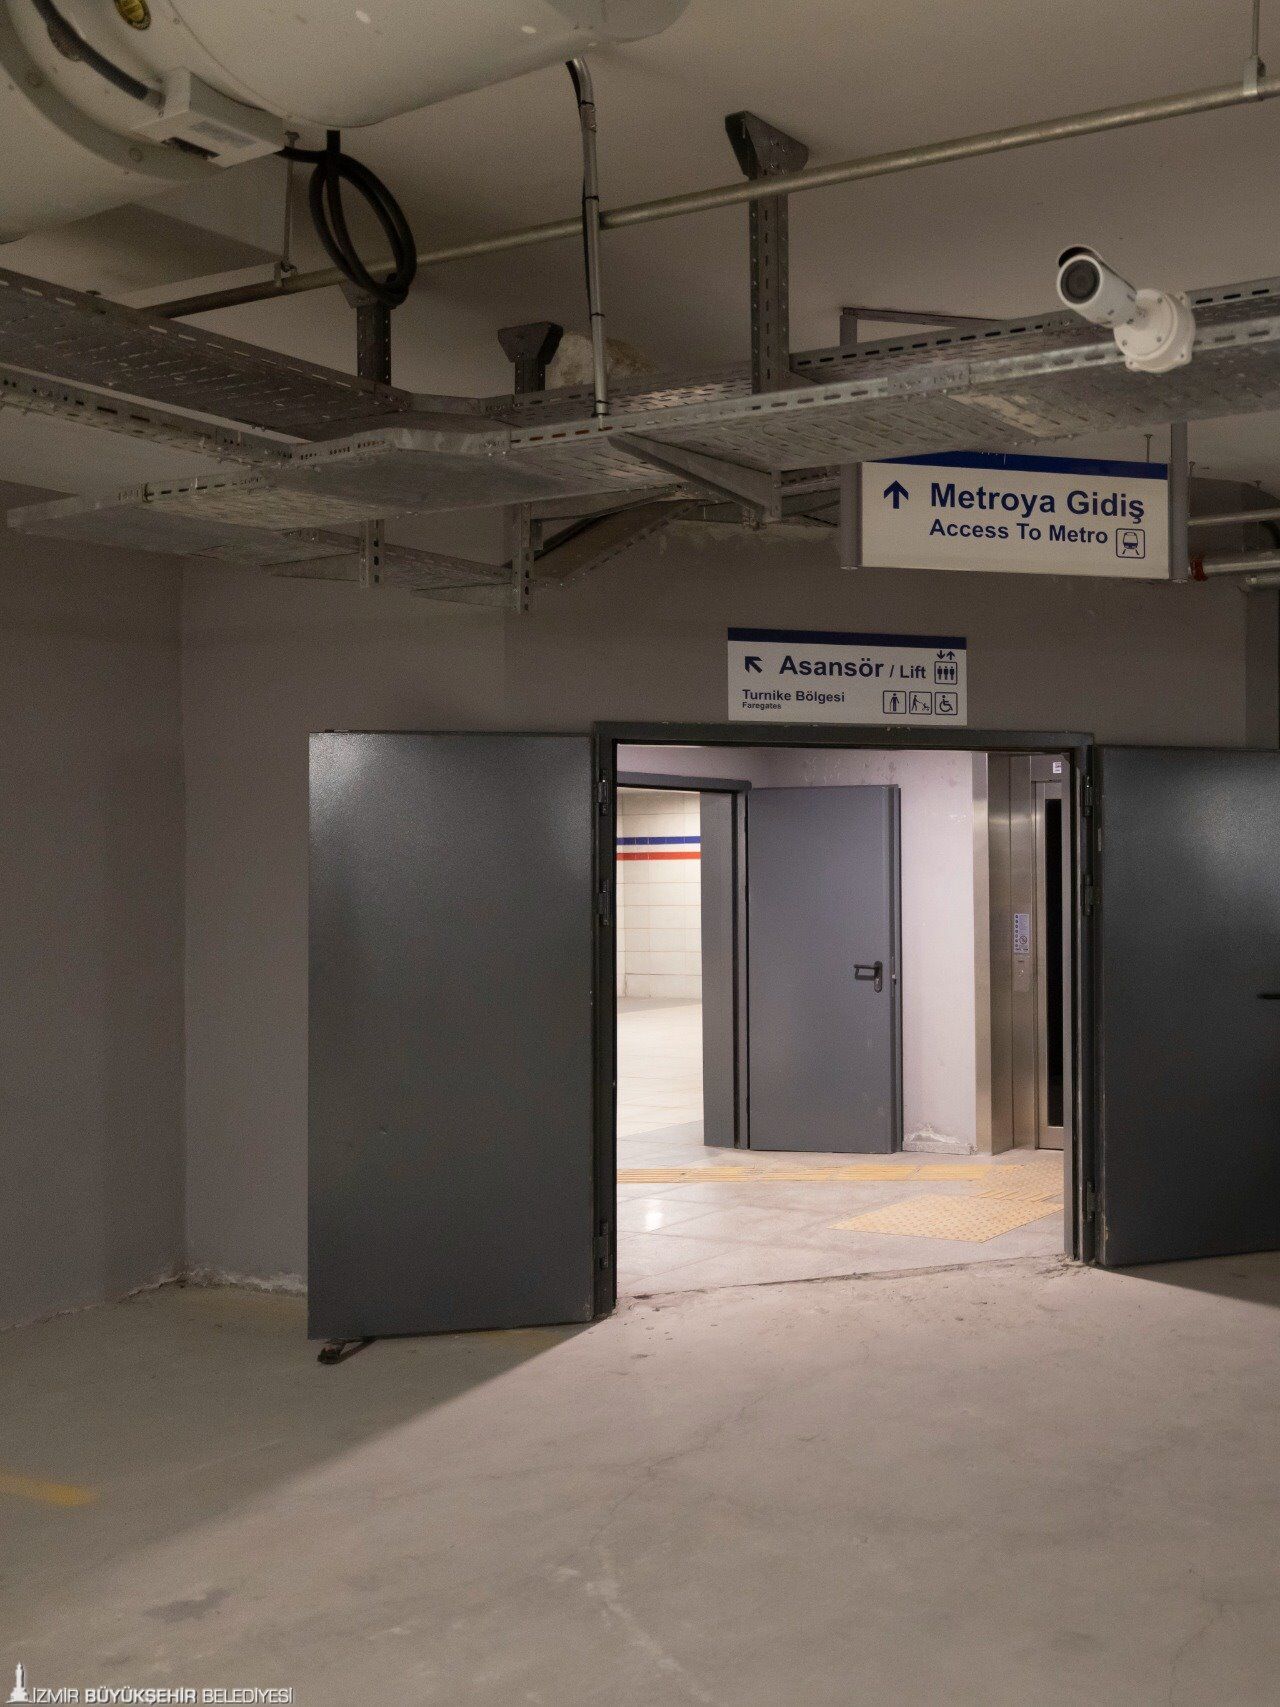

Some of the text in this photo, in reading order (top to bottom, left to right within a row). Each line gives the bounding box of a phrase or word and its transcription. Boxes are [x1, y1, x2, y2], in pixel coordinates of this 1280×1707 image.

[931, 483, 1145, 524] Metroya Gidiş
[929, 519, 1108, 544] Access To Metro
[779, 656, 927, 679] Asansör / Lift
[742, 689, 845, 704] Turnike Bölgesi
[742, 701, 782, 710] Faregates
